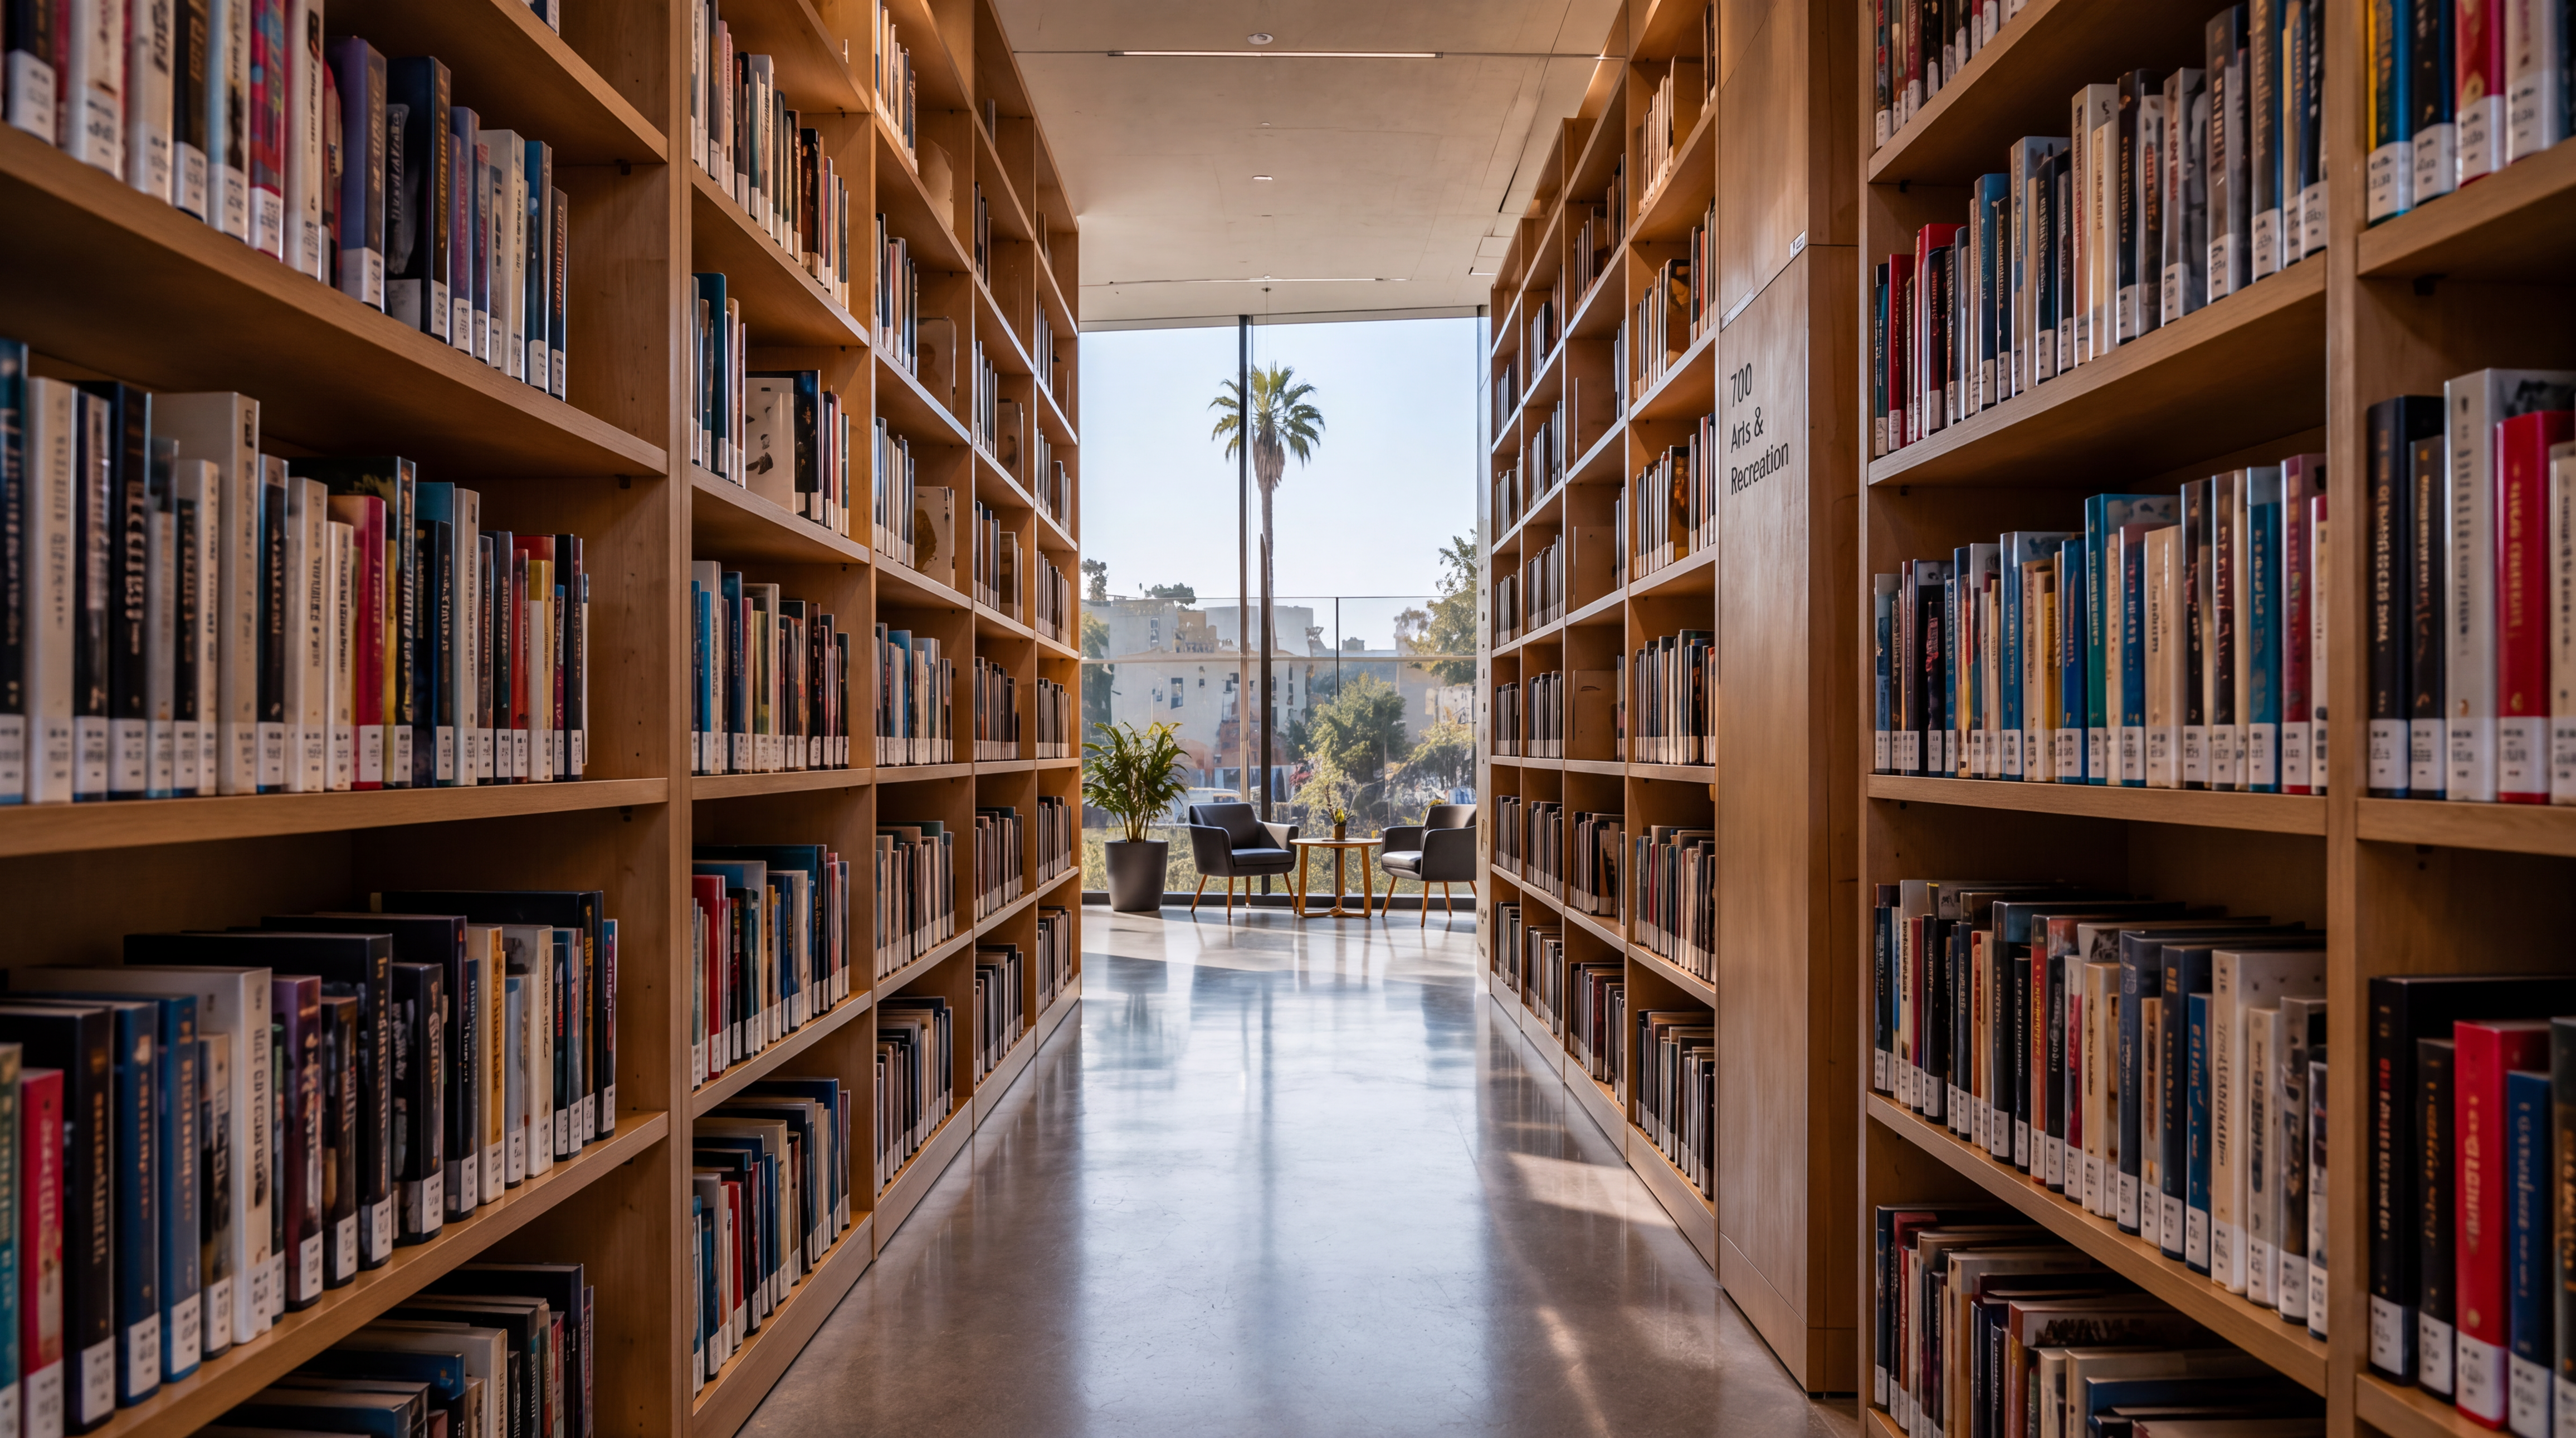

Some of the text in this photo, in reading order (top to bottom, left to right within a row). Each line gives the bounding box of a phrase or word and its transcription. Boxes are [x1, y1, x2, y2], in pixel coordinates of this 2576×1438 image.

[1731, 363, 1752, 407] 700
[1731, 406, 1763, 453] Arts &
[1731, 443, 1788, 495] Recreation
